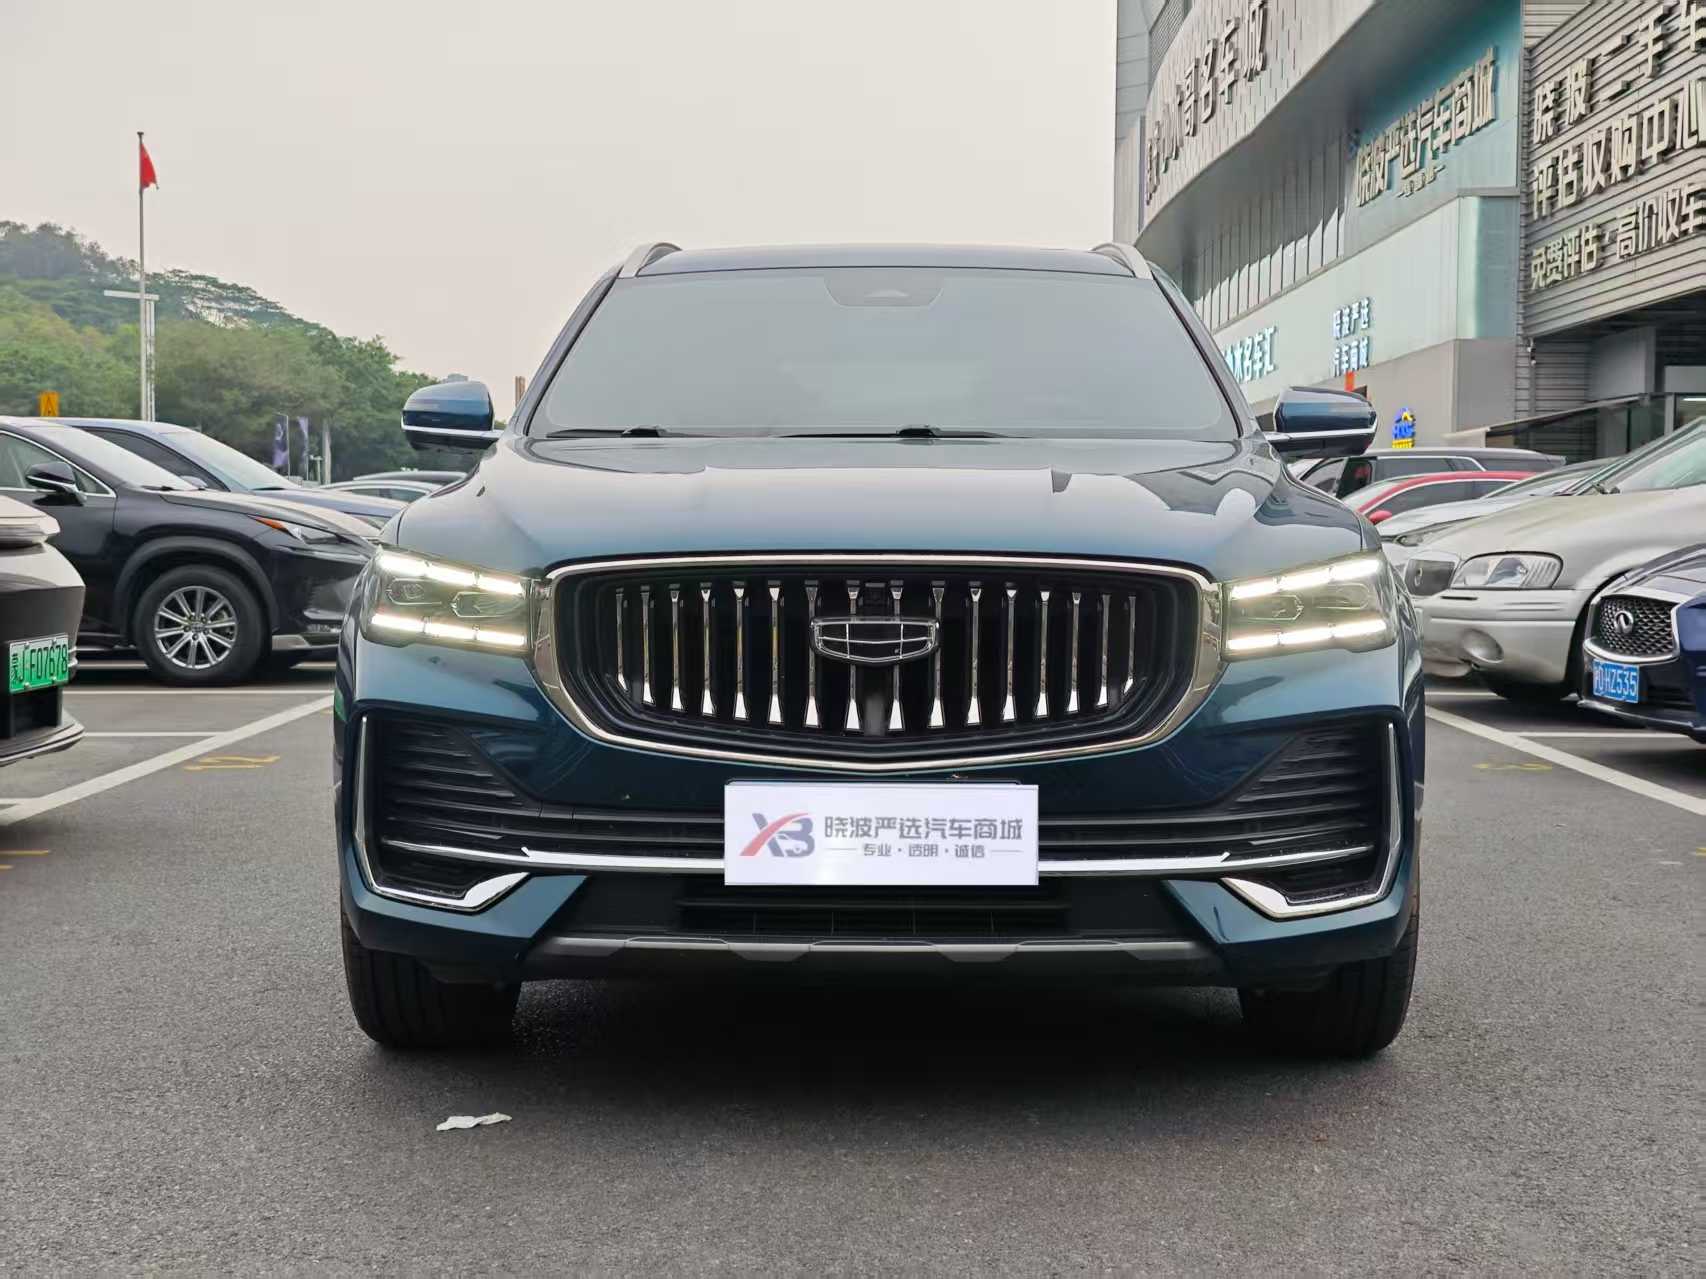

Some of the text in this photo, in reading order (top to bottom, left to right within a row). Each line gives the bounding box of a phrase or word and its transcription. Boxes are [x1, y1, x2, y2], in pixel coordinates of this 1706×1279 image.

[824, 816, 1023, 841] 晓波严选汽车商城
